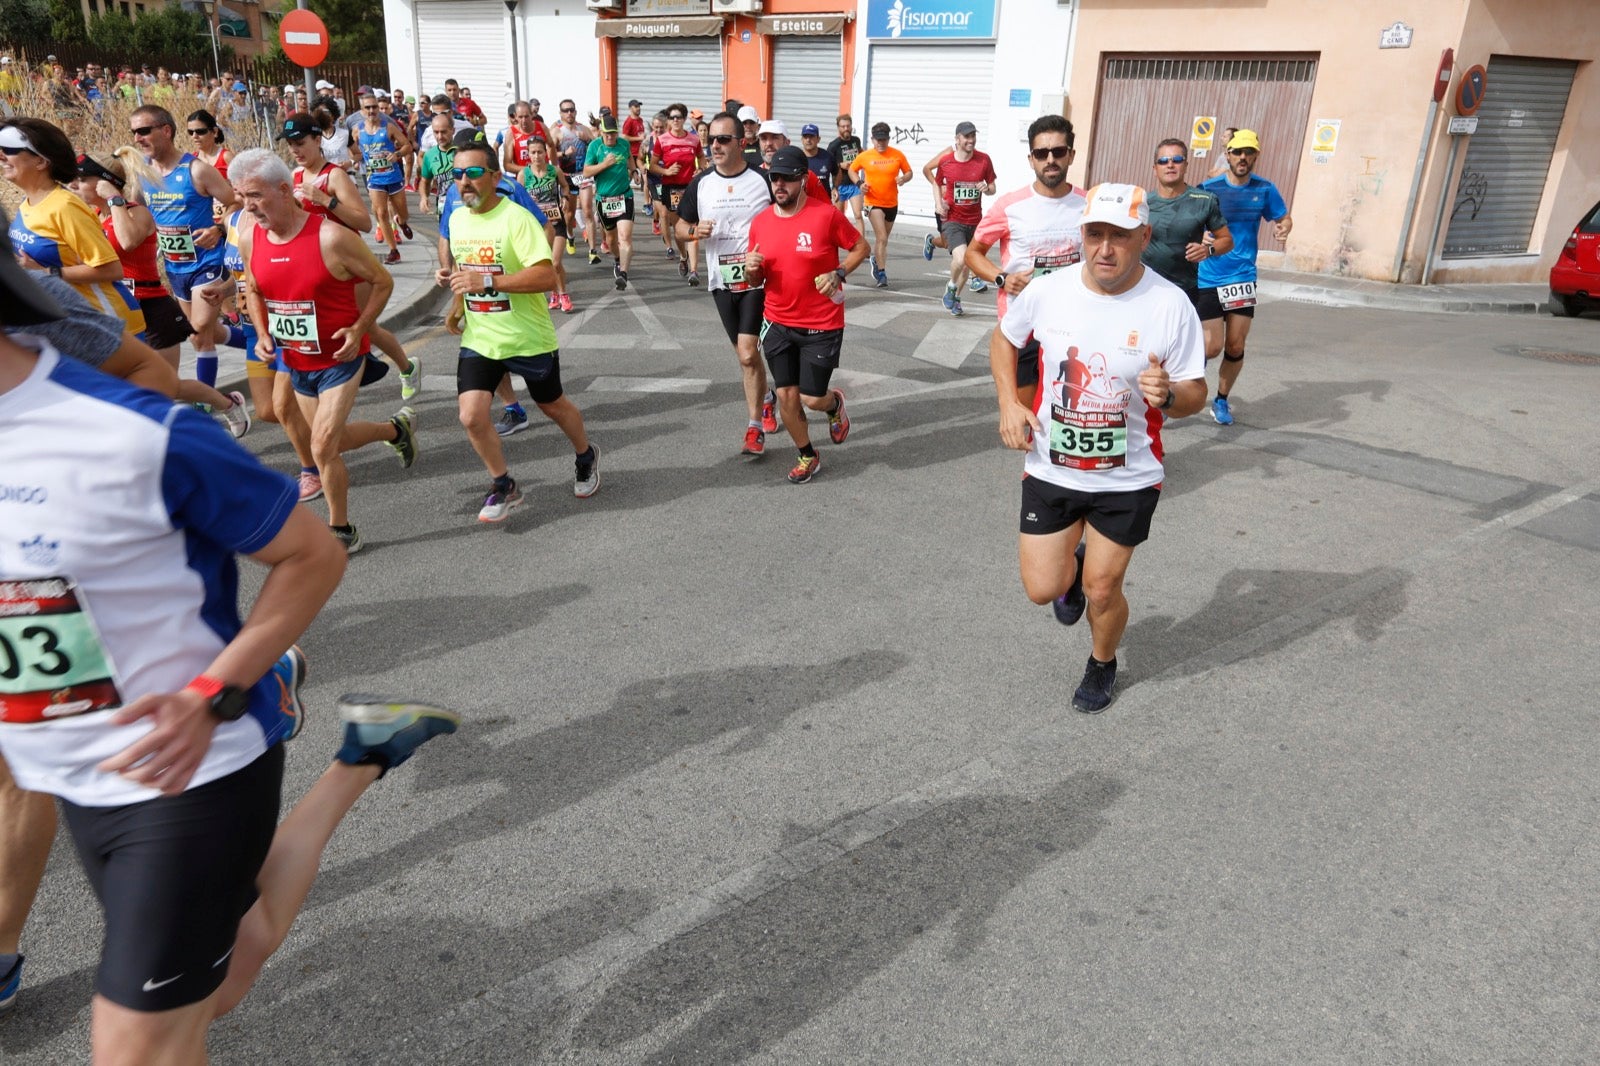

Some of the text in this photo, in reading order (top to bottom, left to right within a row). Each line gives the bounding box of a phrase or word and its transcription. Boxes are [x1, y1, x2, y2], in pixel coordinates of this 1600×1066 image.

[902, 7, 973, 30] fisiomar
[626, 23, 680, 35] Peluqueria
[773, 20, 823, 31] Estetica
[152, 192, 184, 200] olimpo
[956, 189, 979, 198] 1185
[606, 201, 622, 210] 469
[1222, 284, 1252, 298] 3010
[276, 317, 308, 337] 405
[1065, 410, 1078, 420] GRAN
[1098, 413, 1103, 421] DE
[1105, 412, 1123, 422] FONDO
[1061, 427, 1114, 453] 355
